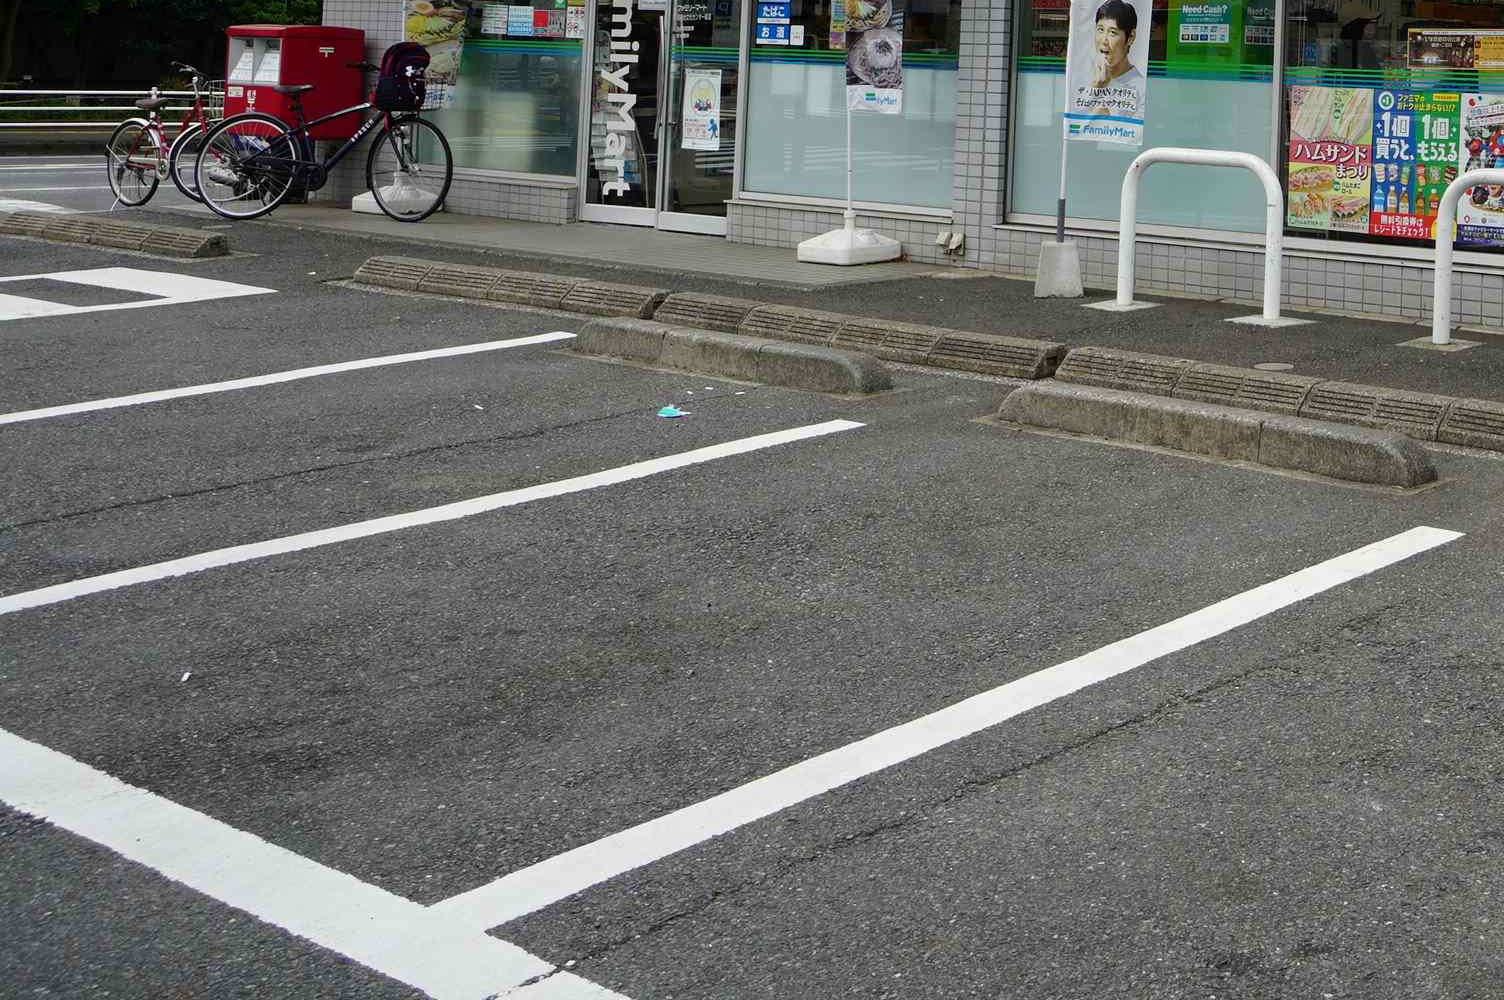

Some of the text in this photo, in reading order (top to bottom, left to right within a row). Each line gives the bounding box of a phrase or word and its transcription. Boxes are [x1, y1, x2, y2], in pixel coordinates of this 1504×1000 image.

[761, 5, 786, 18] たばこ
[1182, 4, 1202, 14] Need
[1083, 124, 1136, 138] FamilyMart
[1381, 111, 1410, 138] 1個
[1422, 113, 1450, 140] 1個
[1294, 142, 1368, 165] ハムサンド
[1375, 138, 1414, 161] 買うと、
[1416, 140, 1458, 162] もらえる
[1335, 164, 1369, 181] まつり
